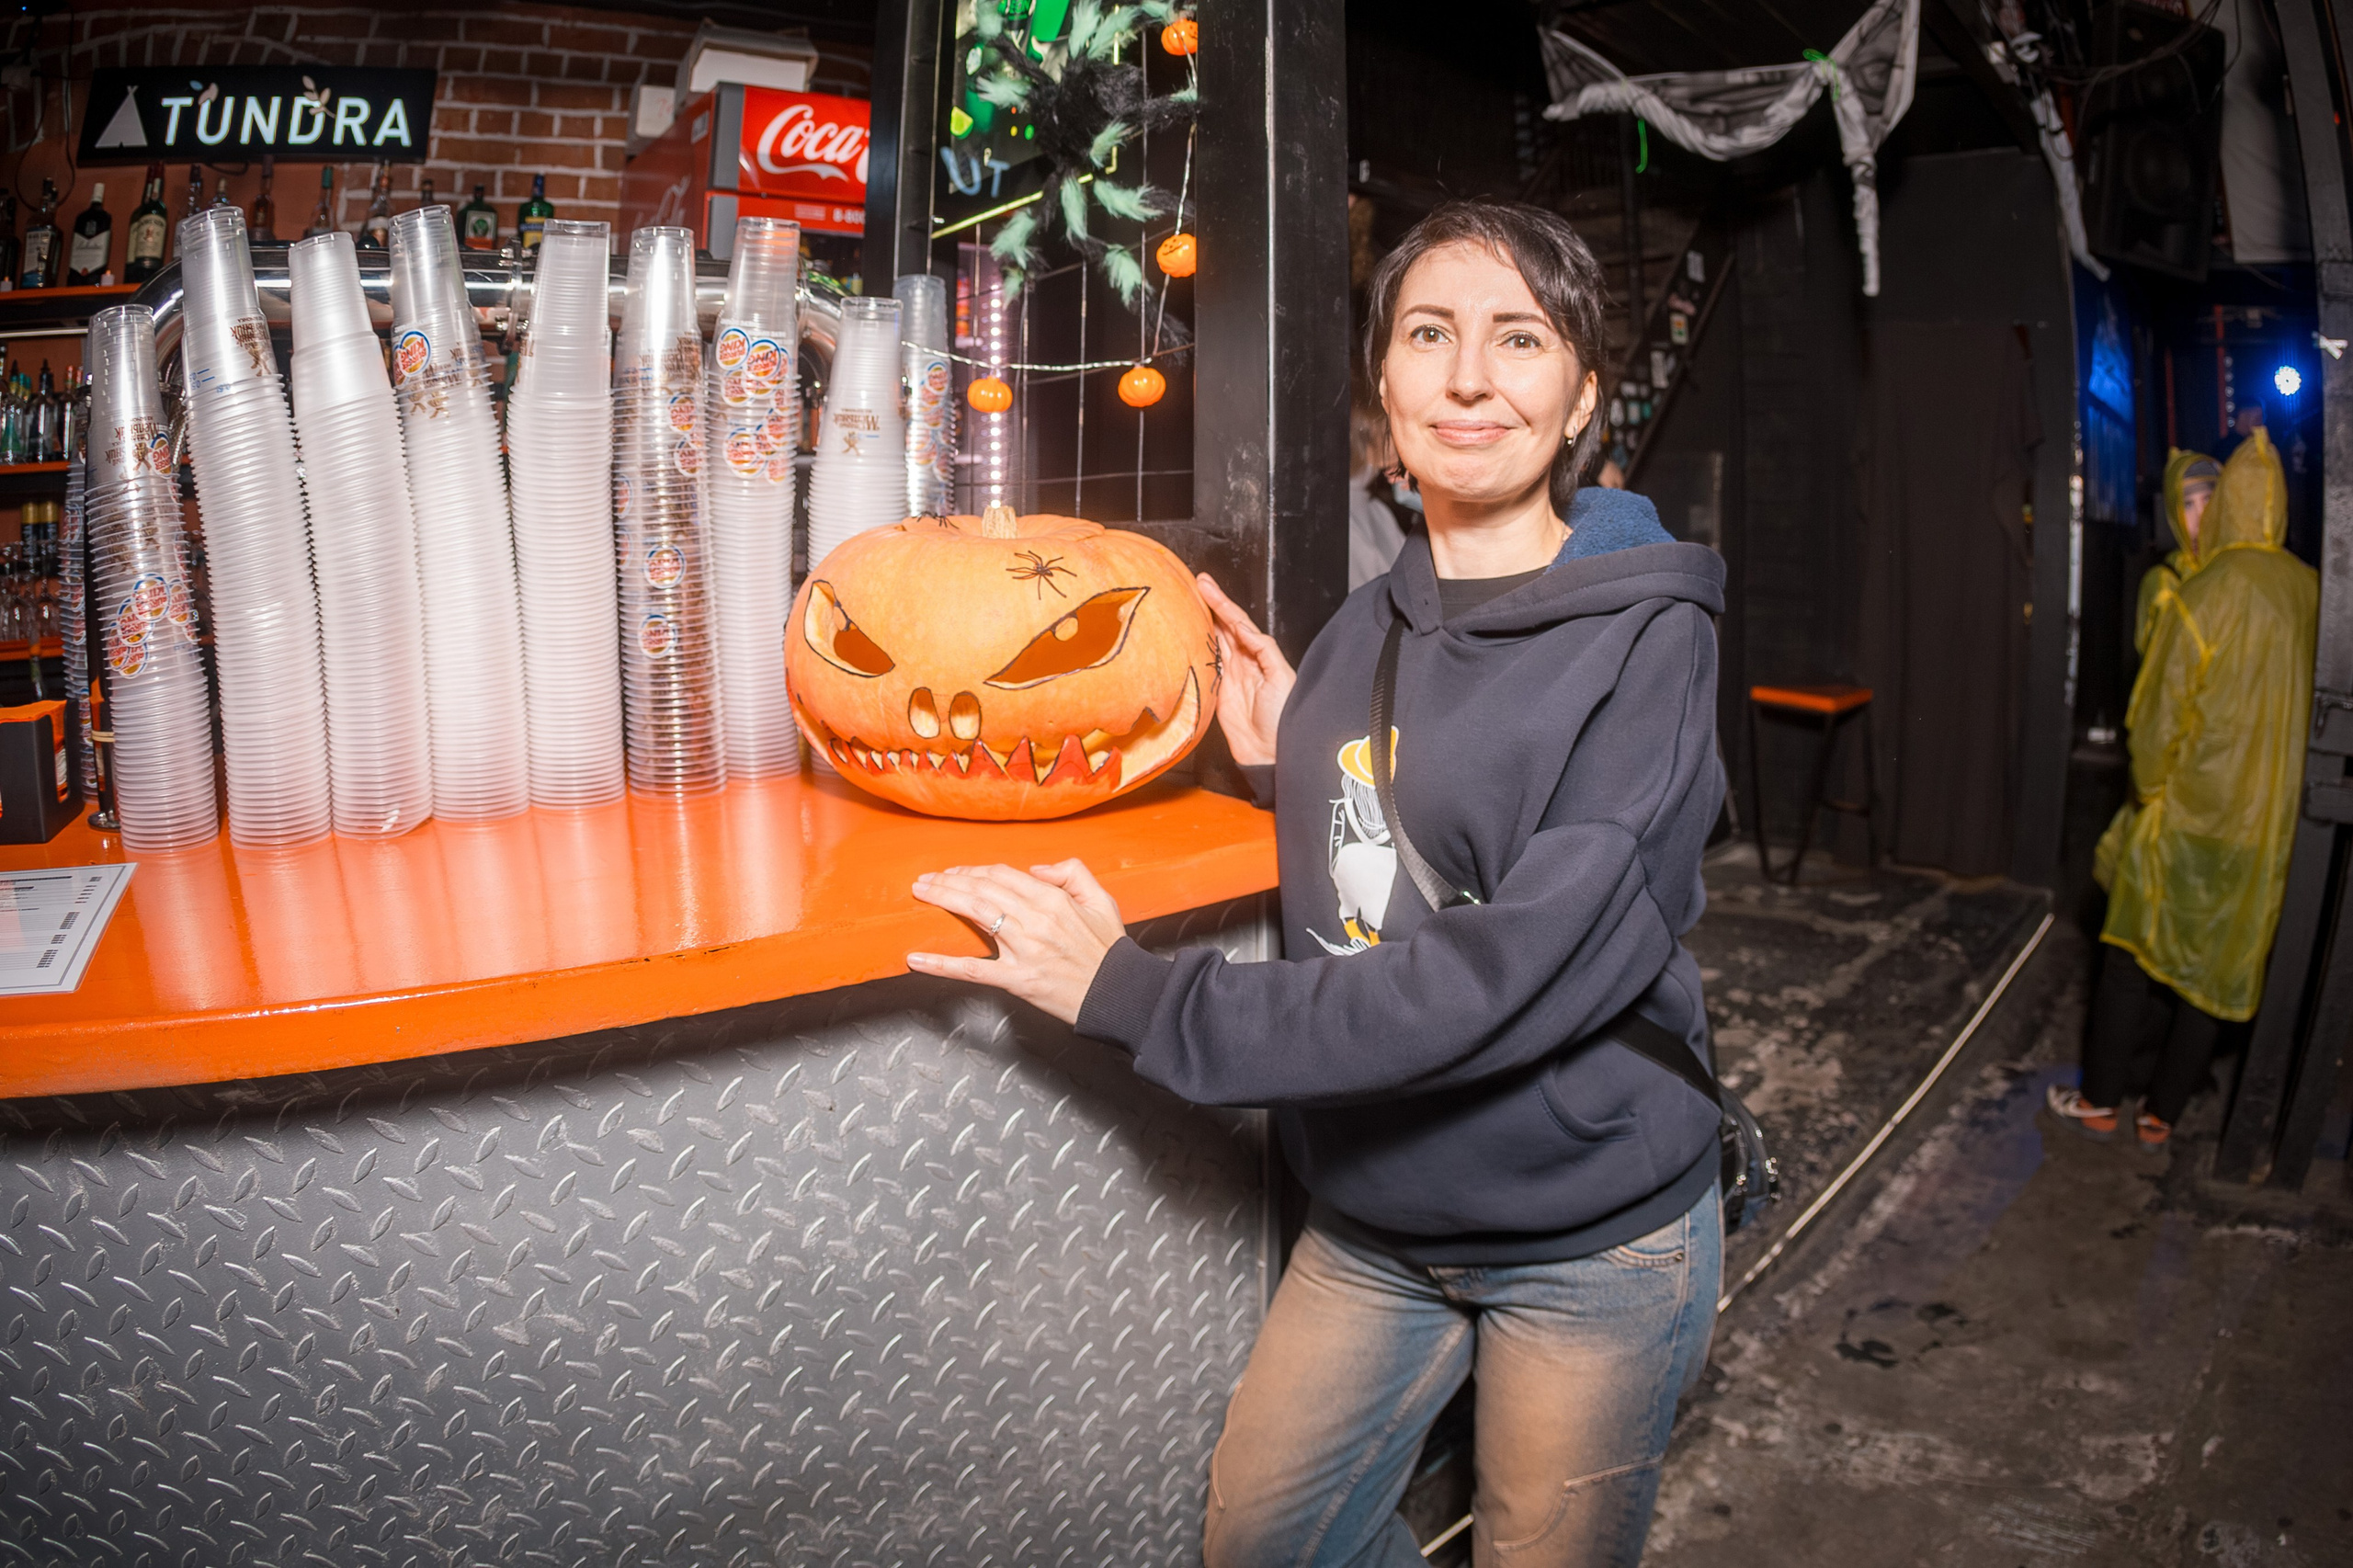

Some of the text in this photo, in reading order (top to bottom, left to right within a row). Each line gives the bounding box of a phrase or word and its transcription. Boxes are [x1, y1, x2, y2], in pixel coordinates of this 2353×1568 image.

[161, 95, 413, 147] TUNDRA
[399, 336, 425, 363] KING
[719, 337, 745, 353] KING
